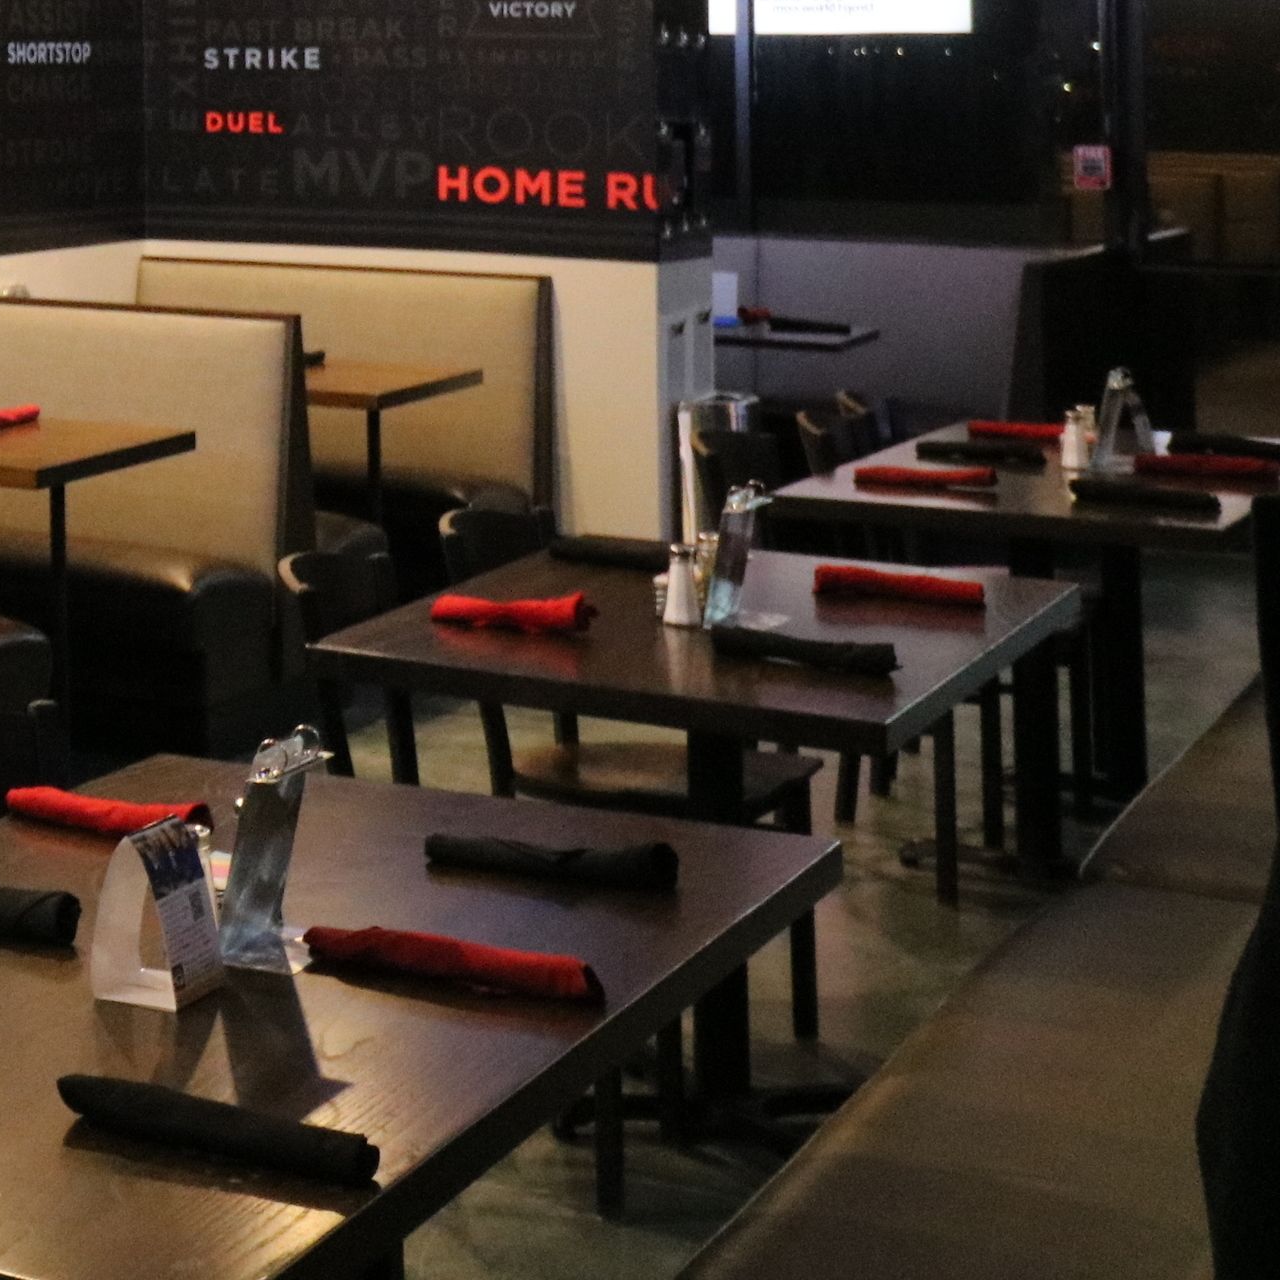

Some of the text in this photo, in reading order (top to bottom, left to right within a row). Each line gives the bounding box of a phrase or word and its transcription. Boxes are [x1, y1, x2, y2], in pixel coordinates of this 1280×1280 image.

[488, 1, 578, 18] VICTORY
[6, 40, 92, 66] SHORTSTOP
[203, 46, 322, 70] STRIKE
[204, 111, 284, 134] DUEL
[436, 165, 588, 208] HOME
